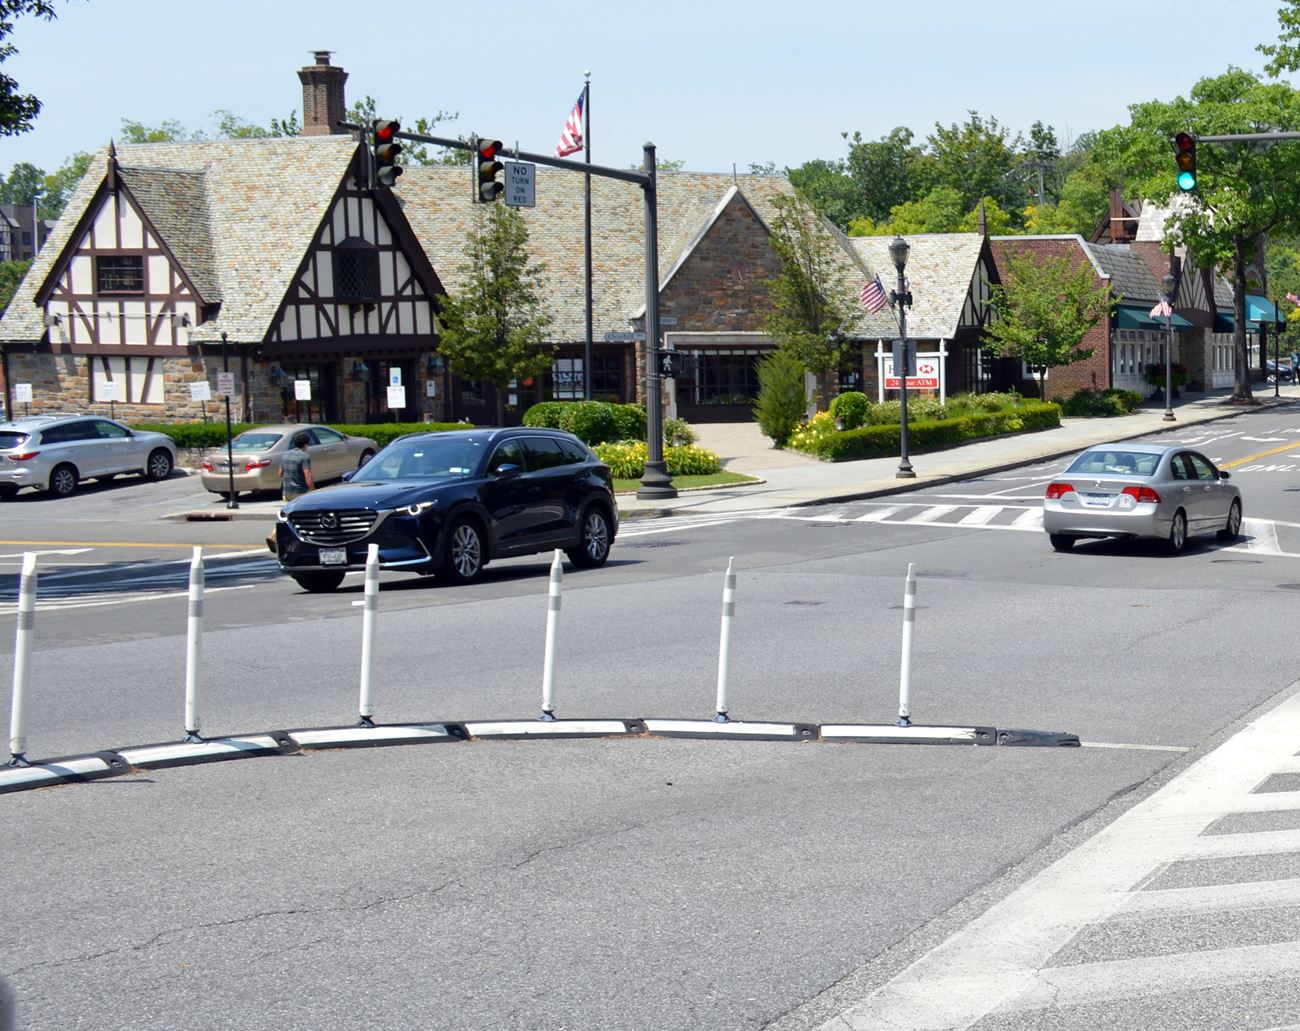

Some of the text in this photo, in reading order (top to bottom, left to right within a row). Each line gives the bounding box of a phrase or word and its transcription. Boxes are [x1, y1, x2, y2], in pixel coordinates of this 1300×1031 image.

[513, 166, 527, 175] NO
[512, 176, 530, 185] TURN
[515, 186, 525, 194] ON
[513, 195, 527, 203] RED
